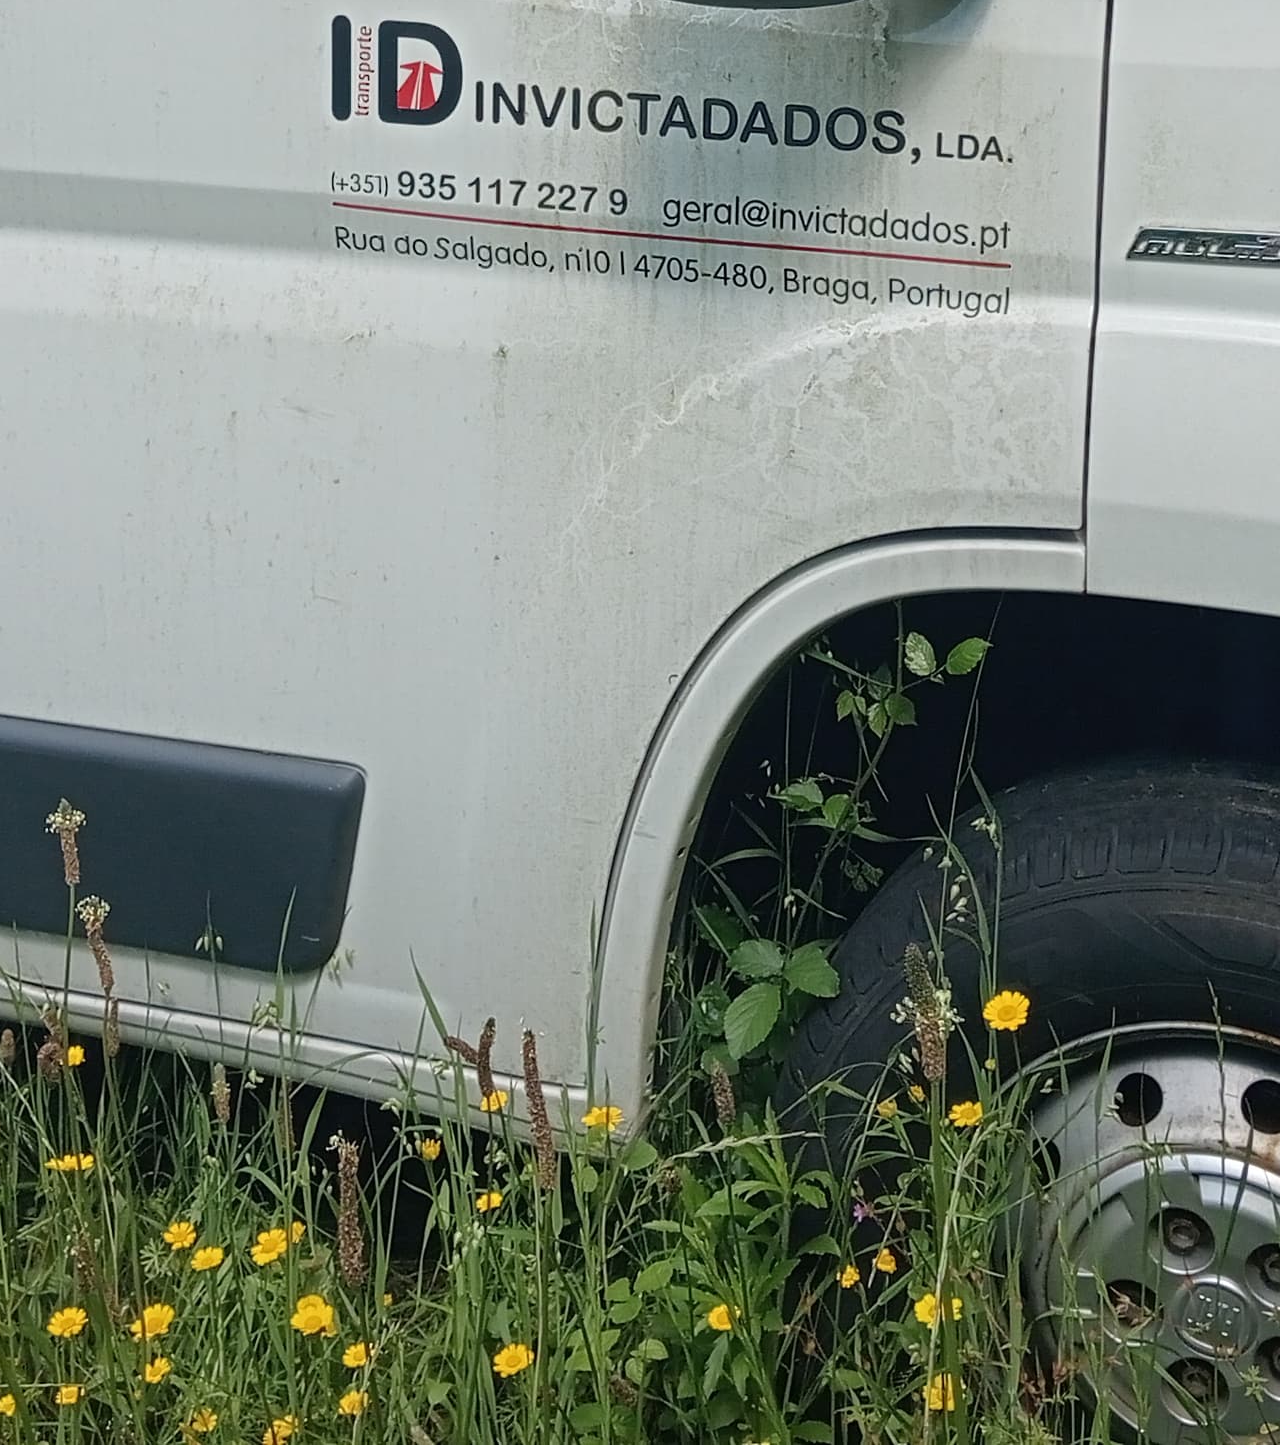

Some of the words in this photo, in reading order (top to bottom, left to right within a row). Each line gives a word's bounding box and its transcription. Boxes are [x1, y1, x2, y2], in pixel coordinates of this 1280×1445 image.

[354, 25, 373, 117] transporte
[475, 80, 921, 164] INVICTADADOS,
[935, 132, 1014, 164] LDA.
[331, 171, 389, 197] (+351)
[397, 170, 457, 201] 935
[468, 177, 527, 207] 117
[537, 183, 598, 214] 227
[609, 189, 628, 216] 9
[662, 196, 1012, 255] geral@invictadados.pt
[334, 226, 386, 252] Rua
[394, 234, 429, 257] do
[433, 237, 555, 273] Salgado,
[633, 256, 775, 294] 4705-480,
[783, 267, 877, 305] Braga,
[888, 277, 1011, 319] Portugal
